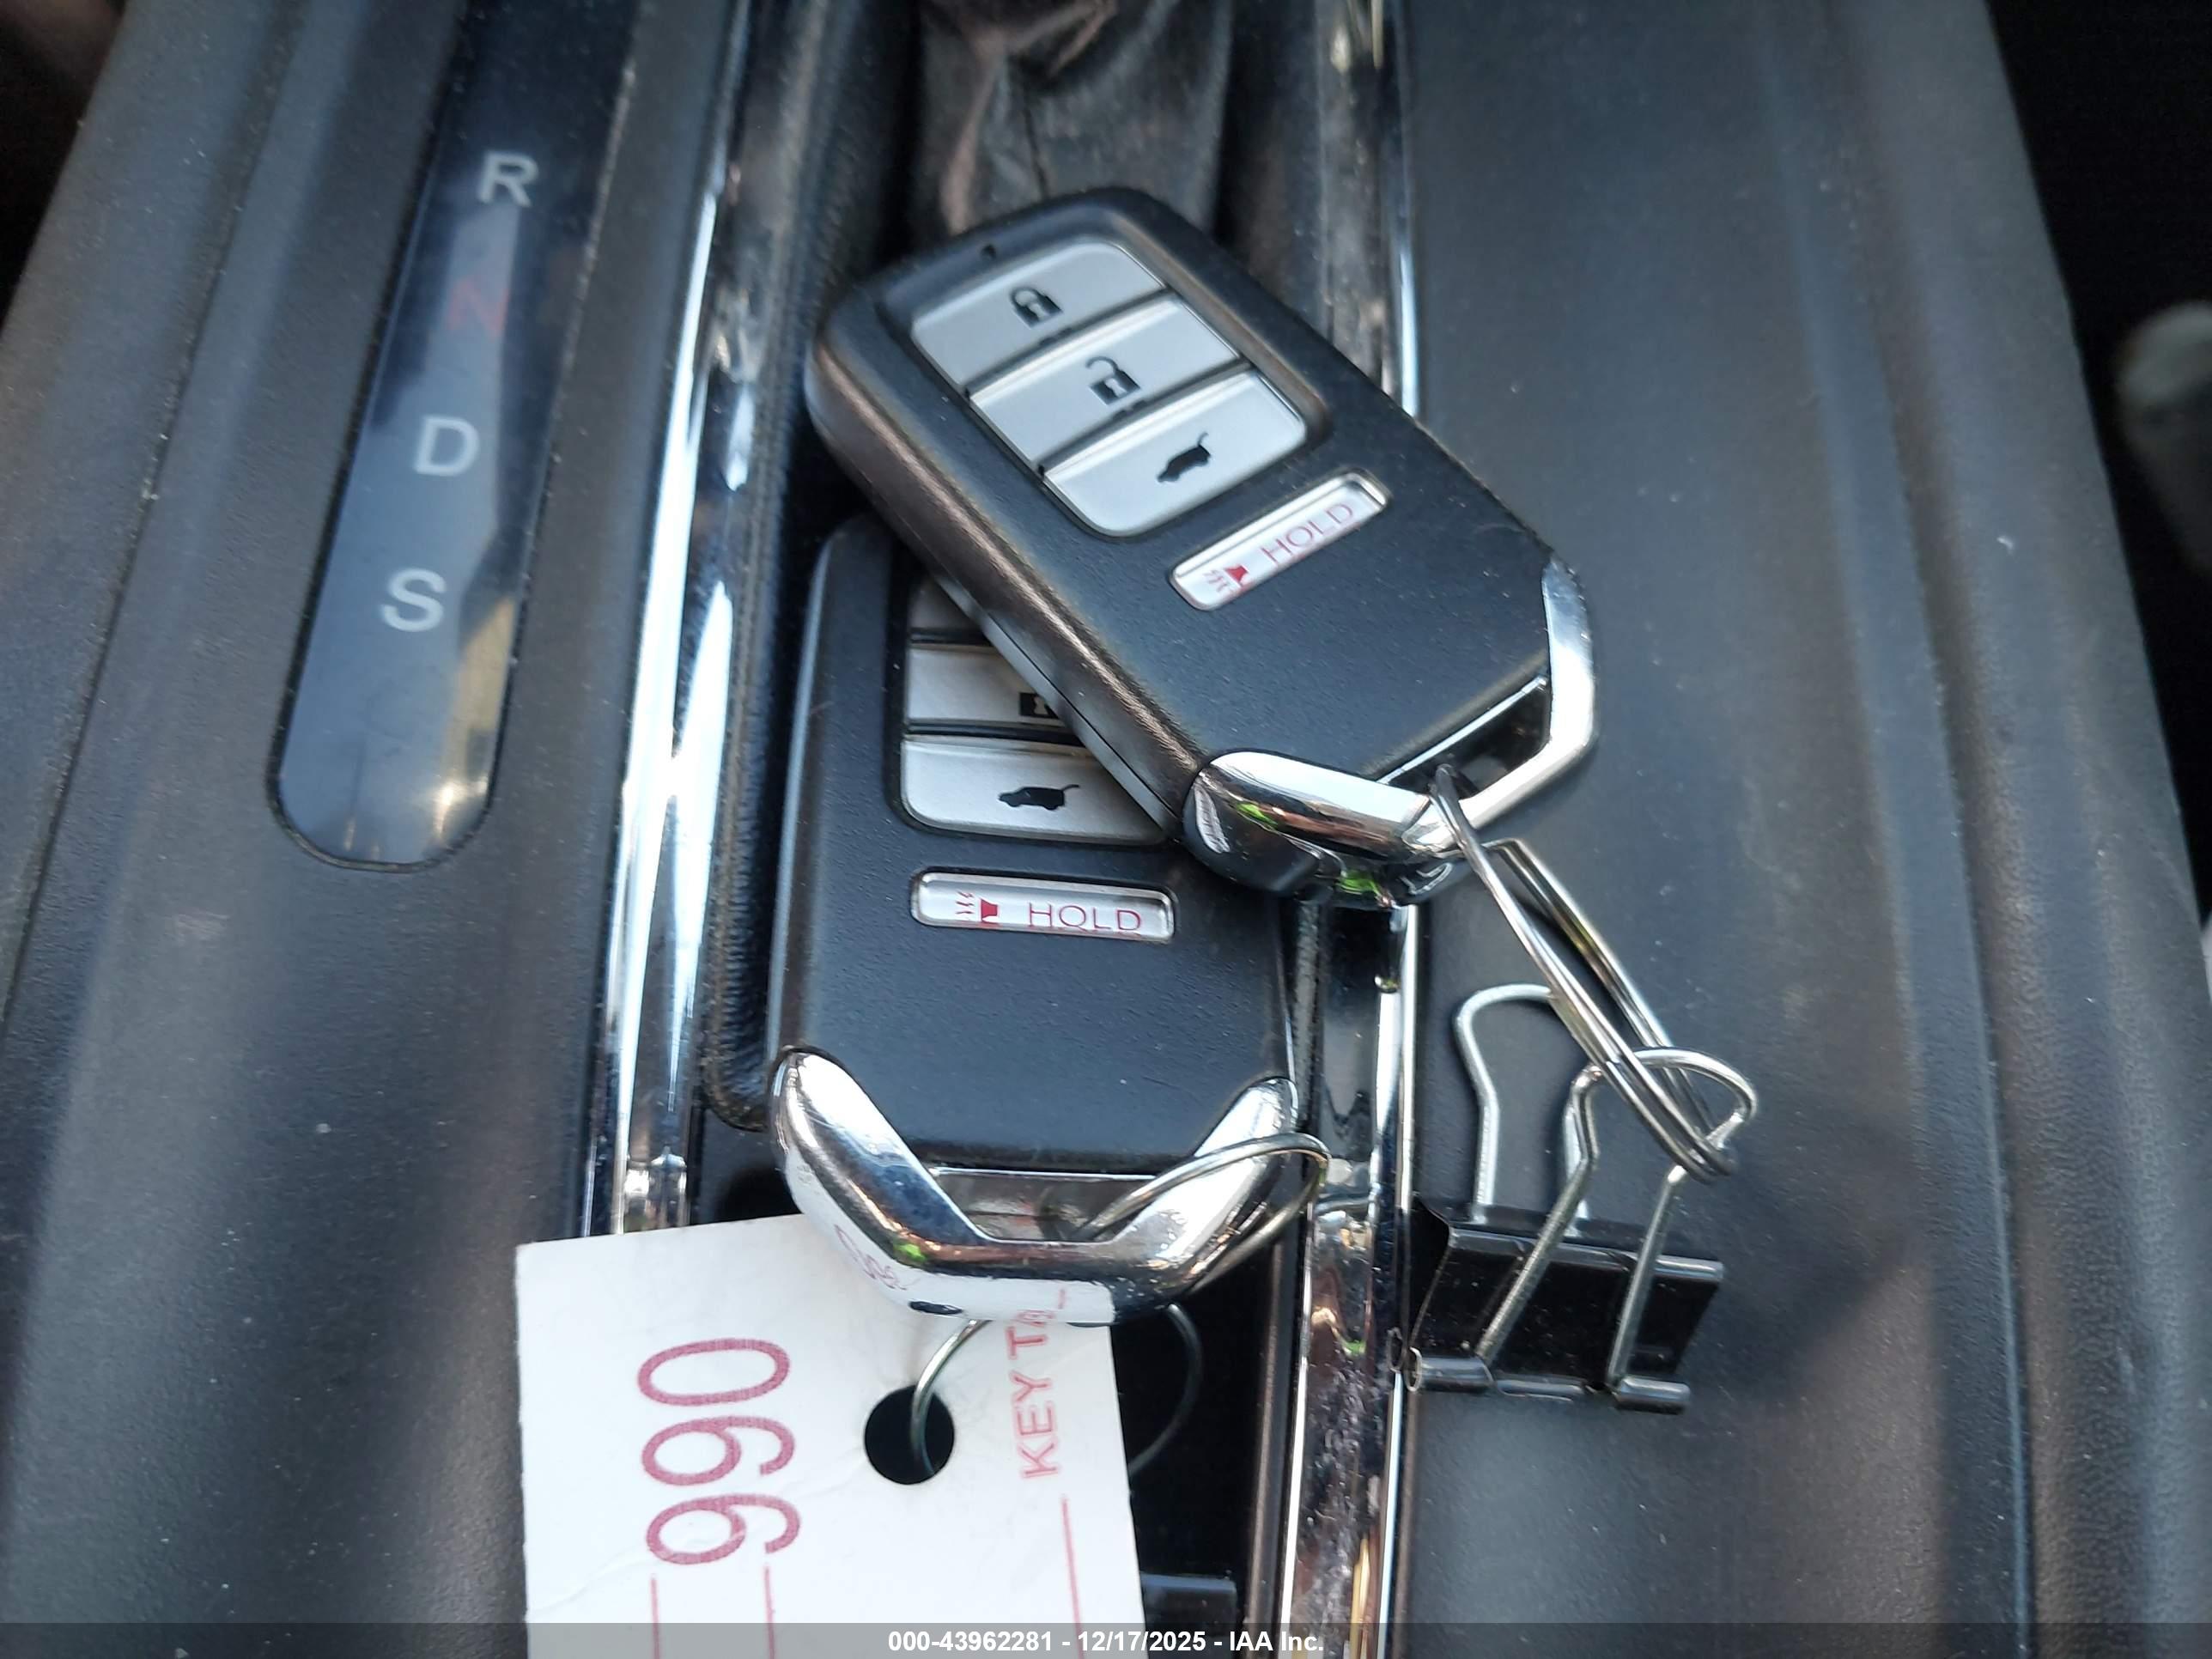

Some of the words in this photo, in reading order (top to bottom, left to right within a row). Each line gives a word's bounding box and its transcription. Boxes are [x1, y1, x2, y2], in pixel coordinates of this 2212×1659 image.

[476, 150, 538, 207] R
[449, 277, 509, 335] N
[412, 416, 480, 476] D
[1261, 503, 1354, 566] HOLD
[380, 568, 447, 632] S
[1028, 902, 1142, 932] HOLD
[637, 1338, 801, 1565] 990
[1010, 1370, 1060, 1479] KEY
